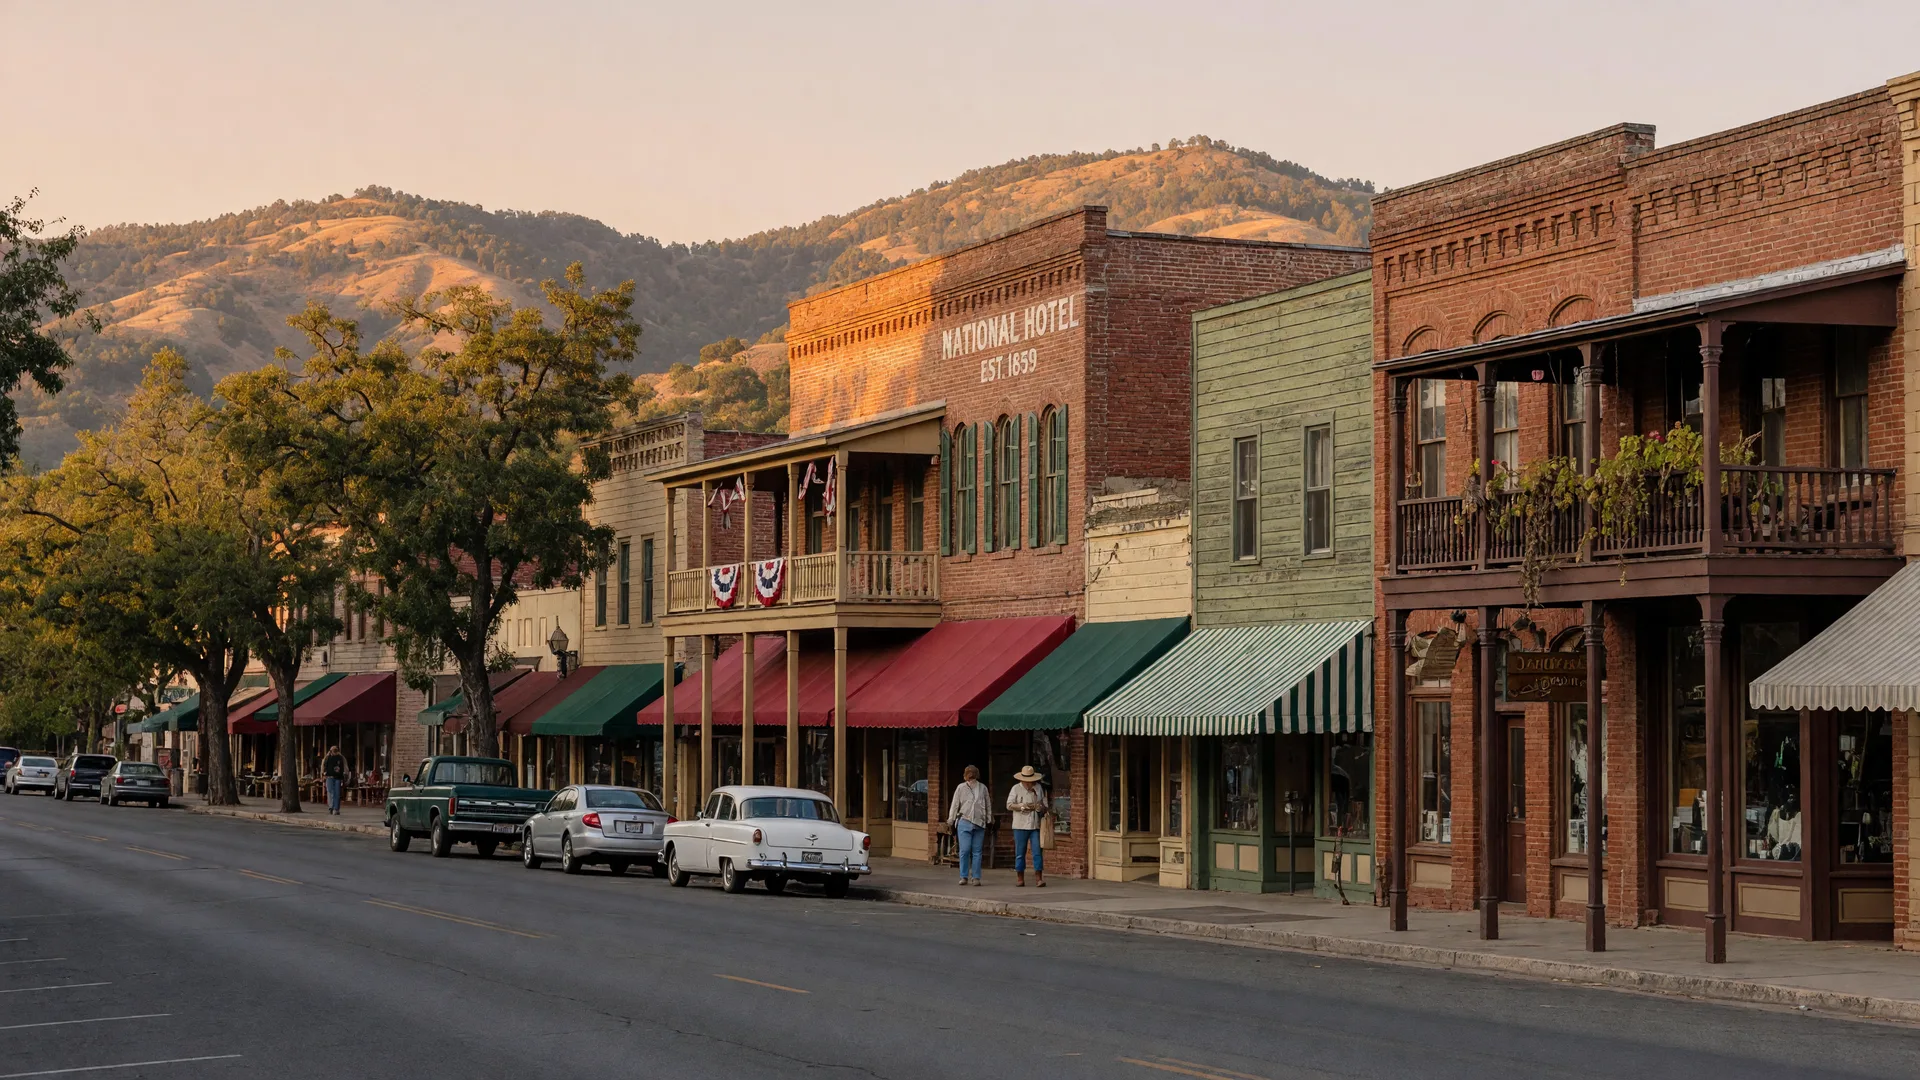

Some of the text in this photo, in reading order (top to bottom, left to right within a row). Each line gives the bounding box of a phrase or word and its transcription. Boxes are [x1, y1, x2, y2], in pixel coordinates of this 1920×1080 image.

[943, 295, 1079, 360] NATIONAL HOTEL
[1008, 348, 1037, 377] 1859
